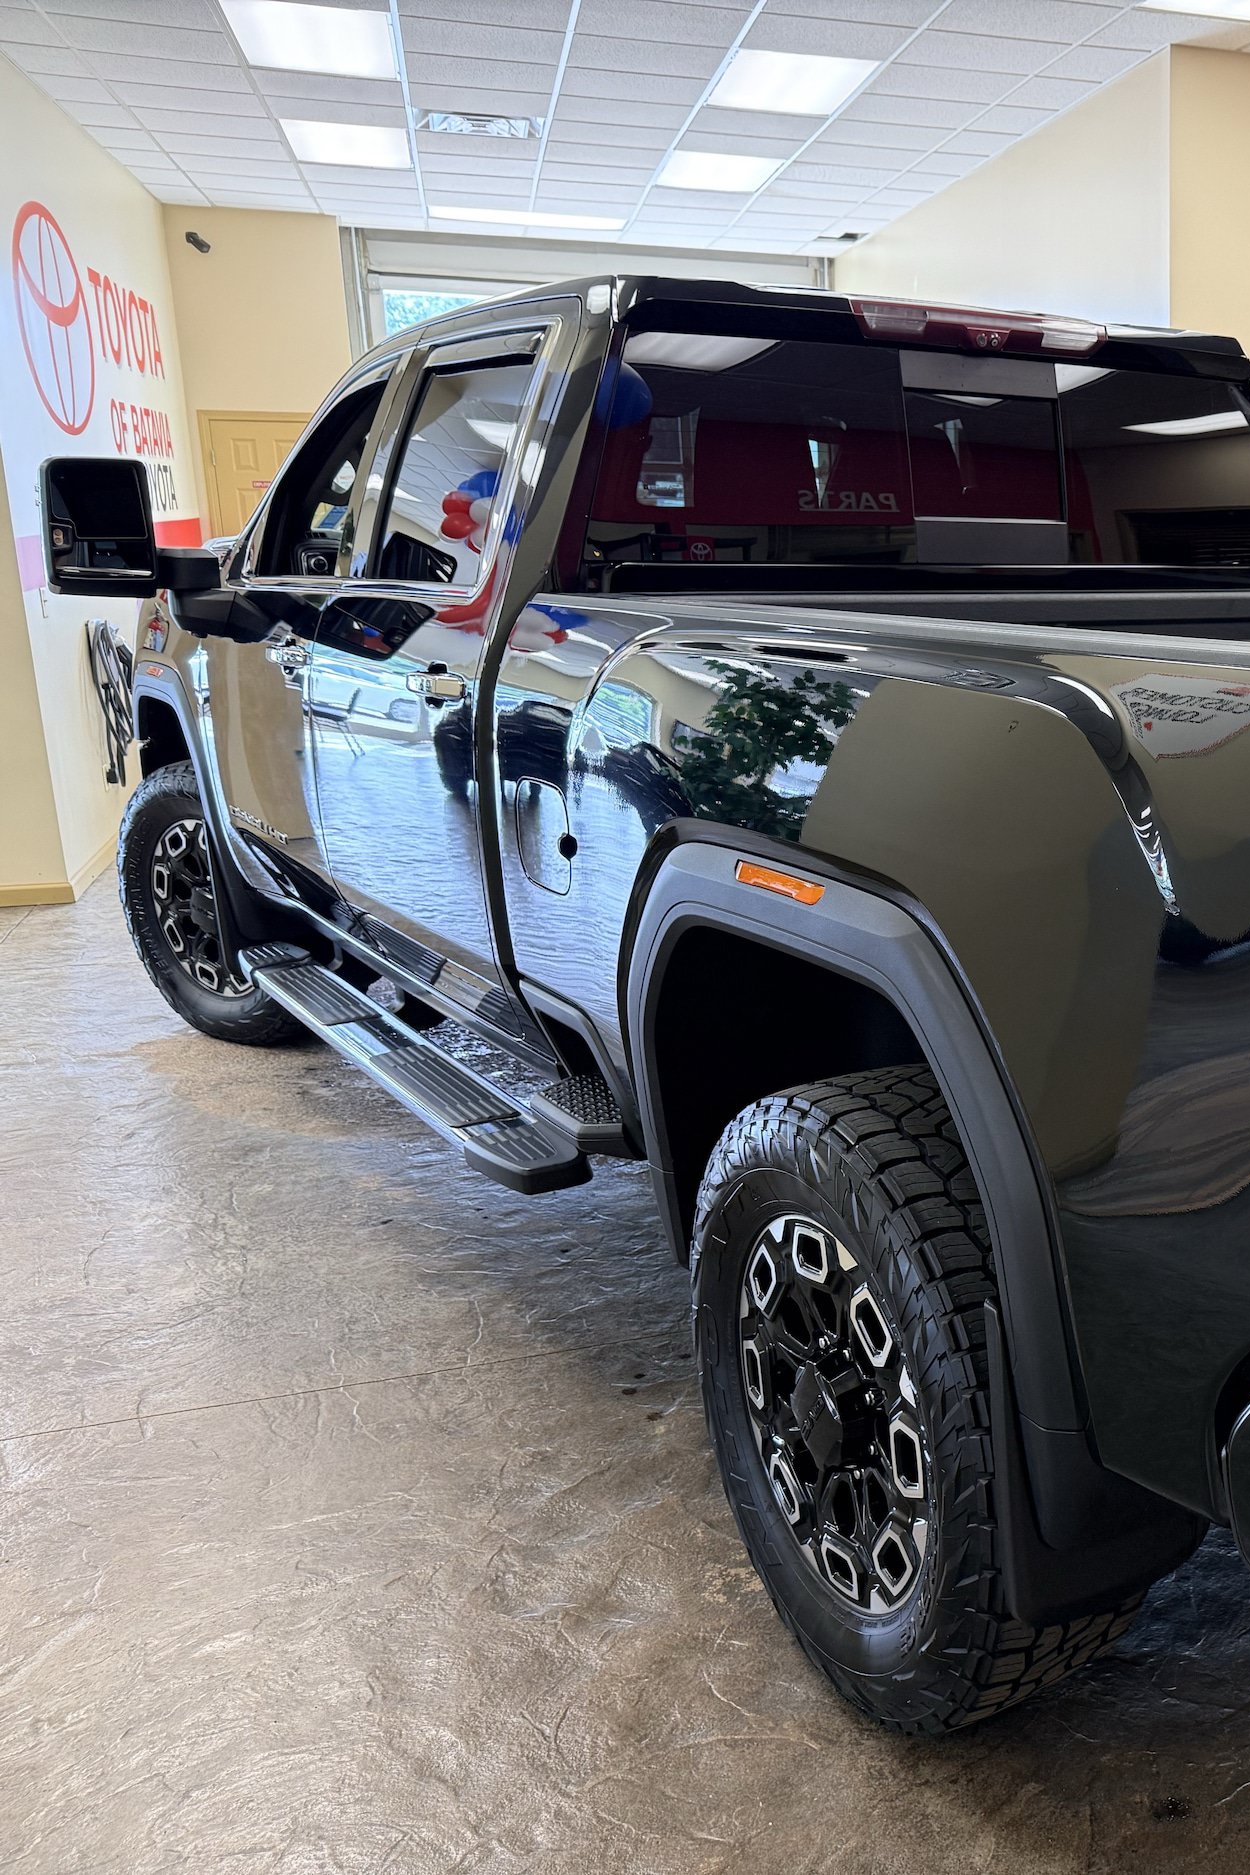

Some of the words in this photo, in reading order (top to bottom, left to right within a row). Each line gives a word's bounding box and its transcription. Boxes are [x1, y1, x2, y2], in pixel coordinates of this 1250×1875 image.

[86, 266, 166, 380] TOYOTA
[110, 398, 128, 455] OF
[130, 403, 175, 459] BATAVIA
